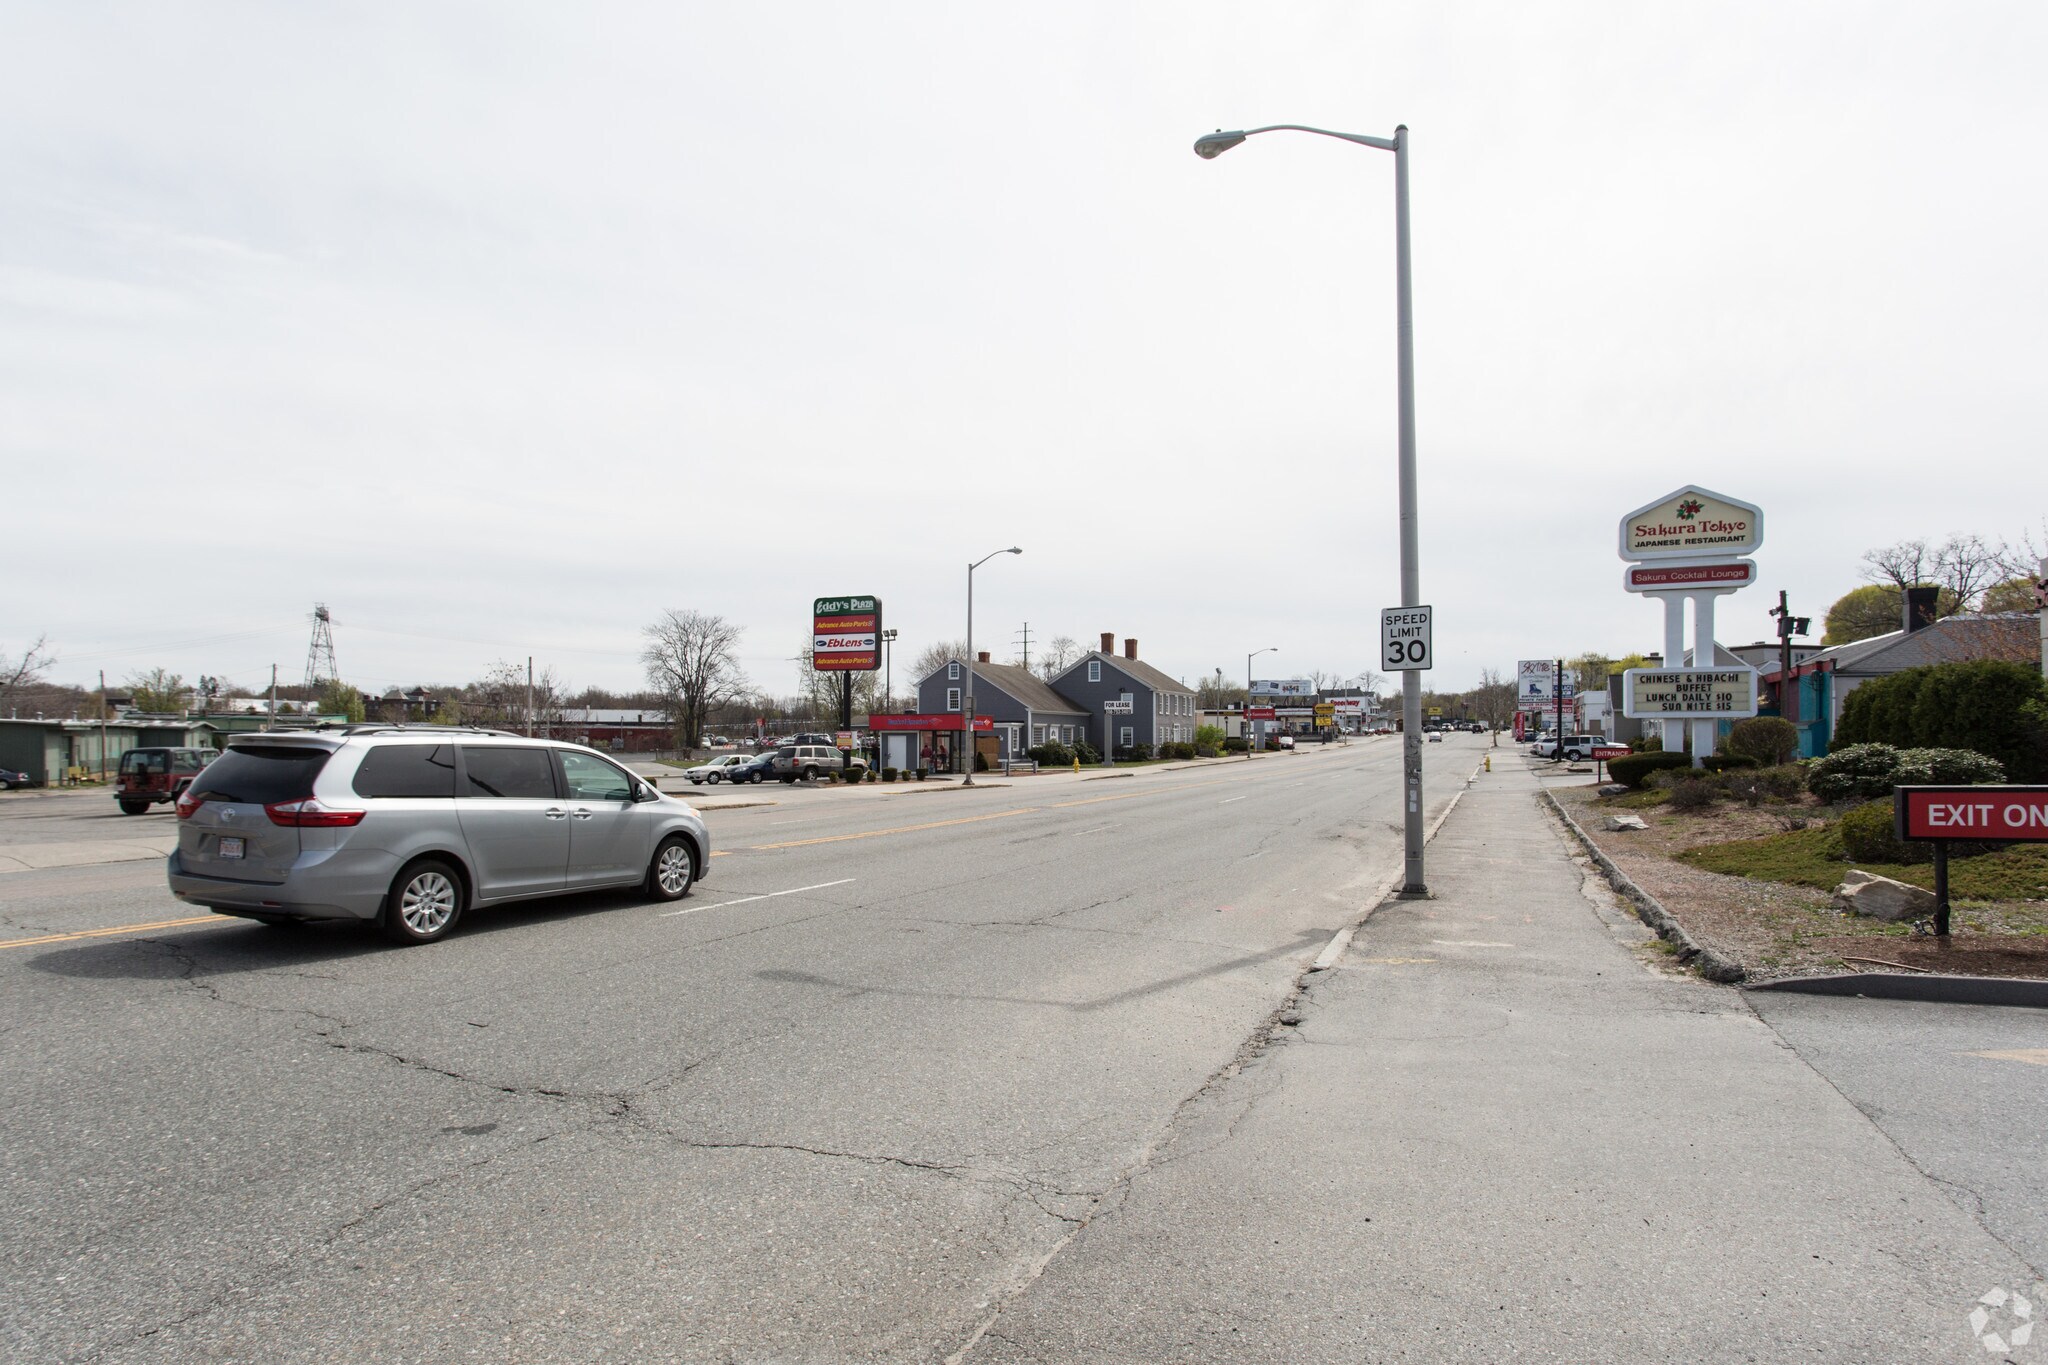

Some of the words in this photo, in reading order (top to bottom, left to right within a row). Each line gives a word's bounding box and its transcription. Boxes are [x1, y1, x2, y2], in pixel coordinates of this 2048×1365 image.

[1635, 523, 1696, 537] Sakura
[1699, 520, 1746, 534] Tokyo
[1635, 539, 1681, 547] JAPANESE
[1685, 535, 1746, 545] RESTAURANT
[1635, 573, 1666, 582] Sakura
[1671, 571, 1707, 580] Cocktail
[1711, 570, 1745, 579] Lounge
[816, 601, 849, 614] Eddy's
[1385, 613, 1427, 625] SPEED
[1390, 627, 1422, 638] LIMIT
[827, 638, 863, 648] EbLens
[1388, 640, 1426, 664] 30
[1640, 674, 1680, 684] CHINESE
[1686, 674, 1692, 682] &
[1696, 673, 1739, 682] HIBACHI
[1676, 683, 1712, 692] BUFFET
[1646, 693, 1677, 702] LUNCH
[1682, 693, 1711, 701] DAILY
[1716, 692, 1732, 701] $10
[1687, 702, 1711, 711] NITE
[1716, 702, 1732, 710] $15
[1928, 804, 1994, 826] EXIT
[2003, 804, 2048, 827] ON
